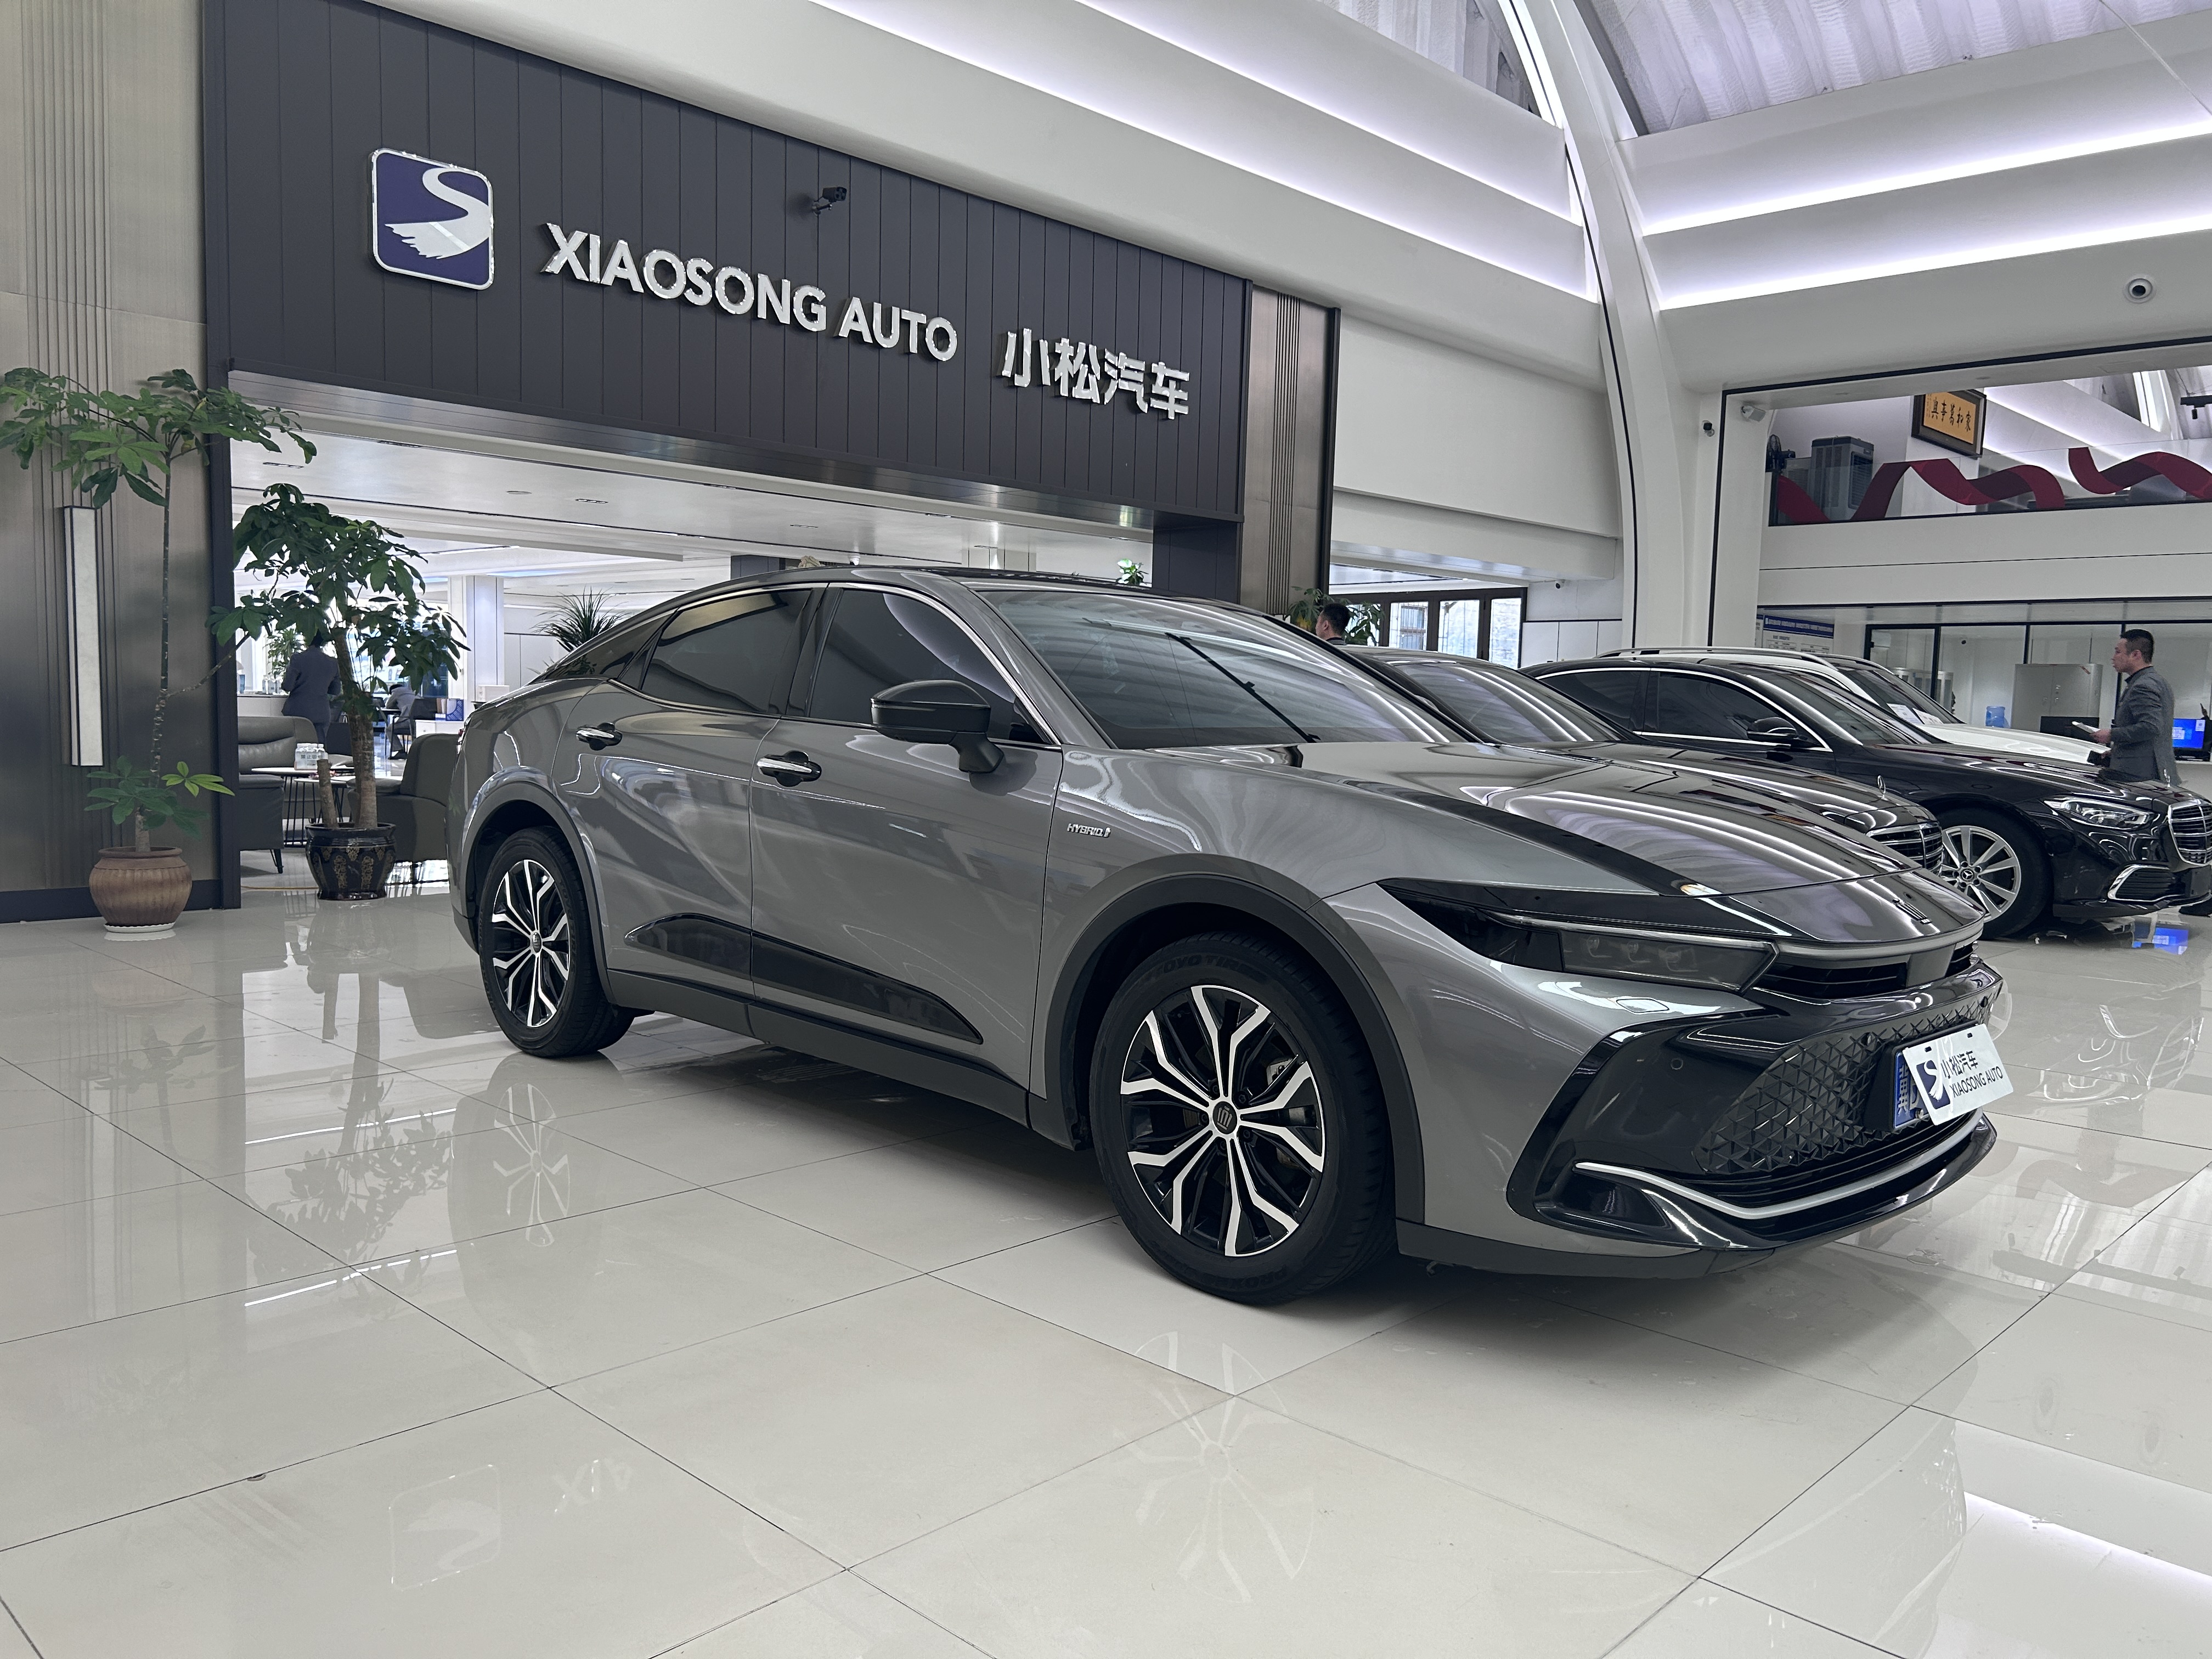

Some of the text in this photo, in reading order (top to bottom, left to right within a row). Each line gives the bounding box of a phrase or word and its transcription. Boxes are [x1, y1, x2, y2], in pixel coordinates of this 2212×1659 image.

[540, 222, 958, 362] XIAOSONG AUTO
[998, 328, 1190, 420] 小松汽车
[1066, 823, 1103, 837] HYBRID
[1940, 1051, 1978, 1079] 小松汽车
[1949, 1066, 2003, 1098] XIAOSONG AUTO
